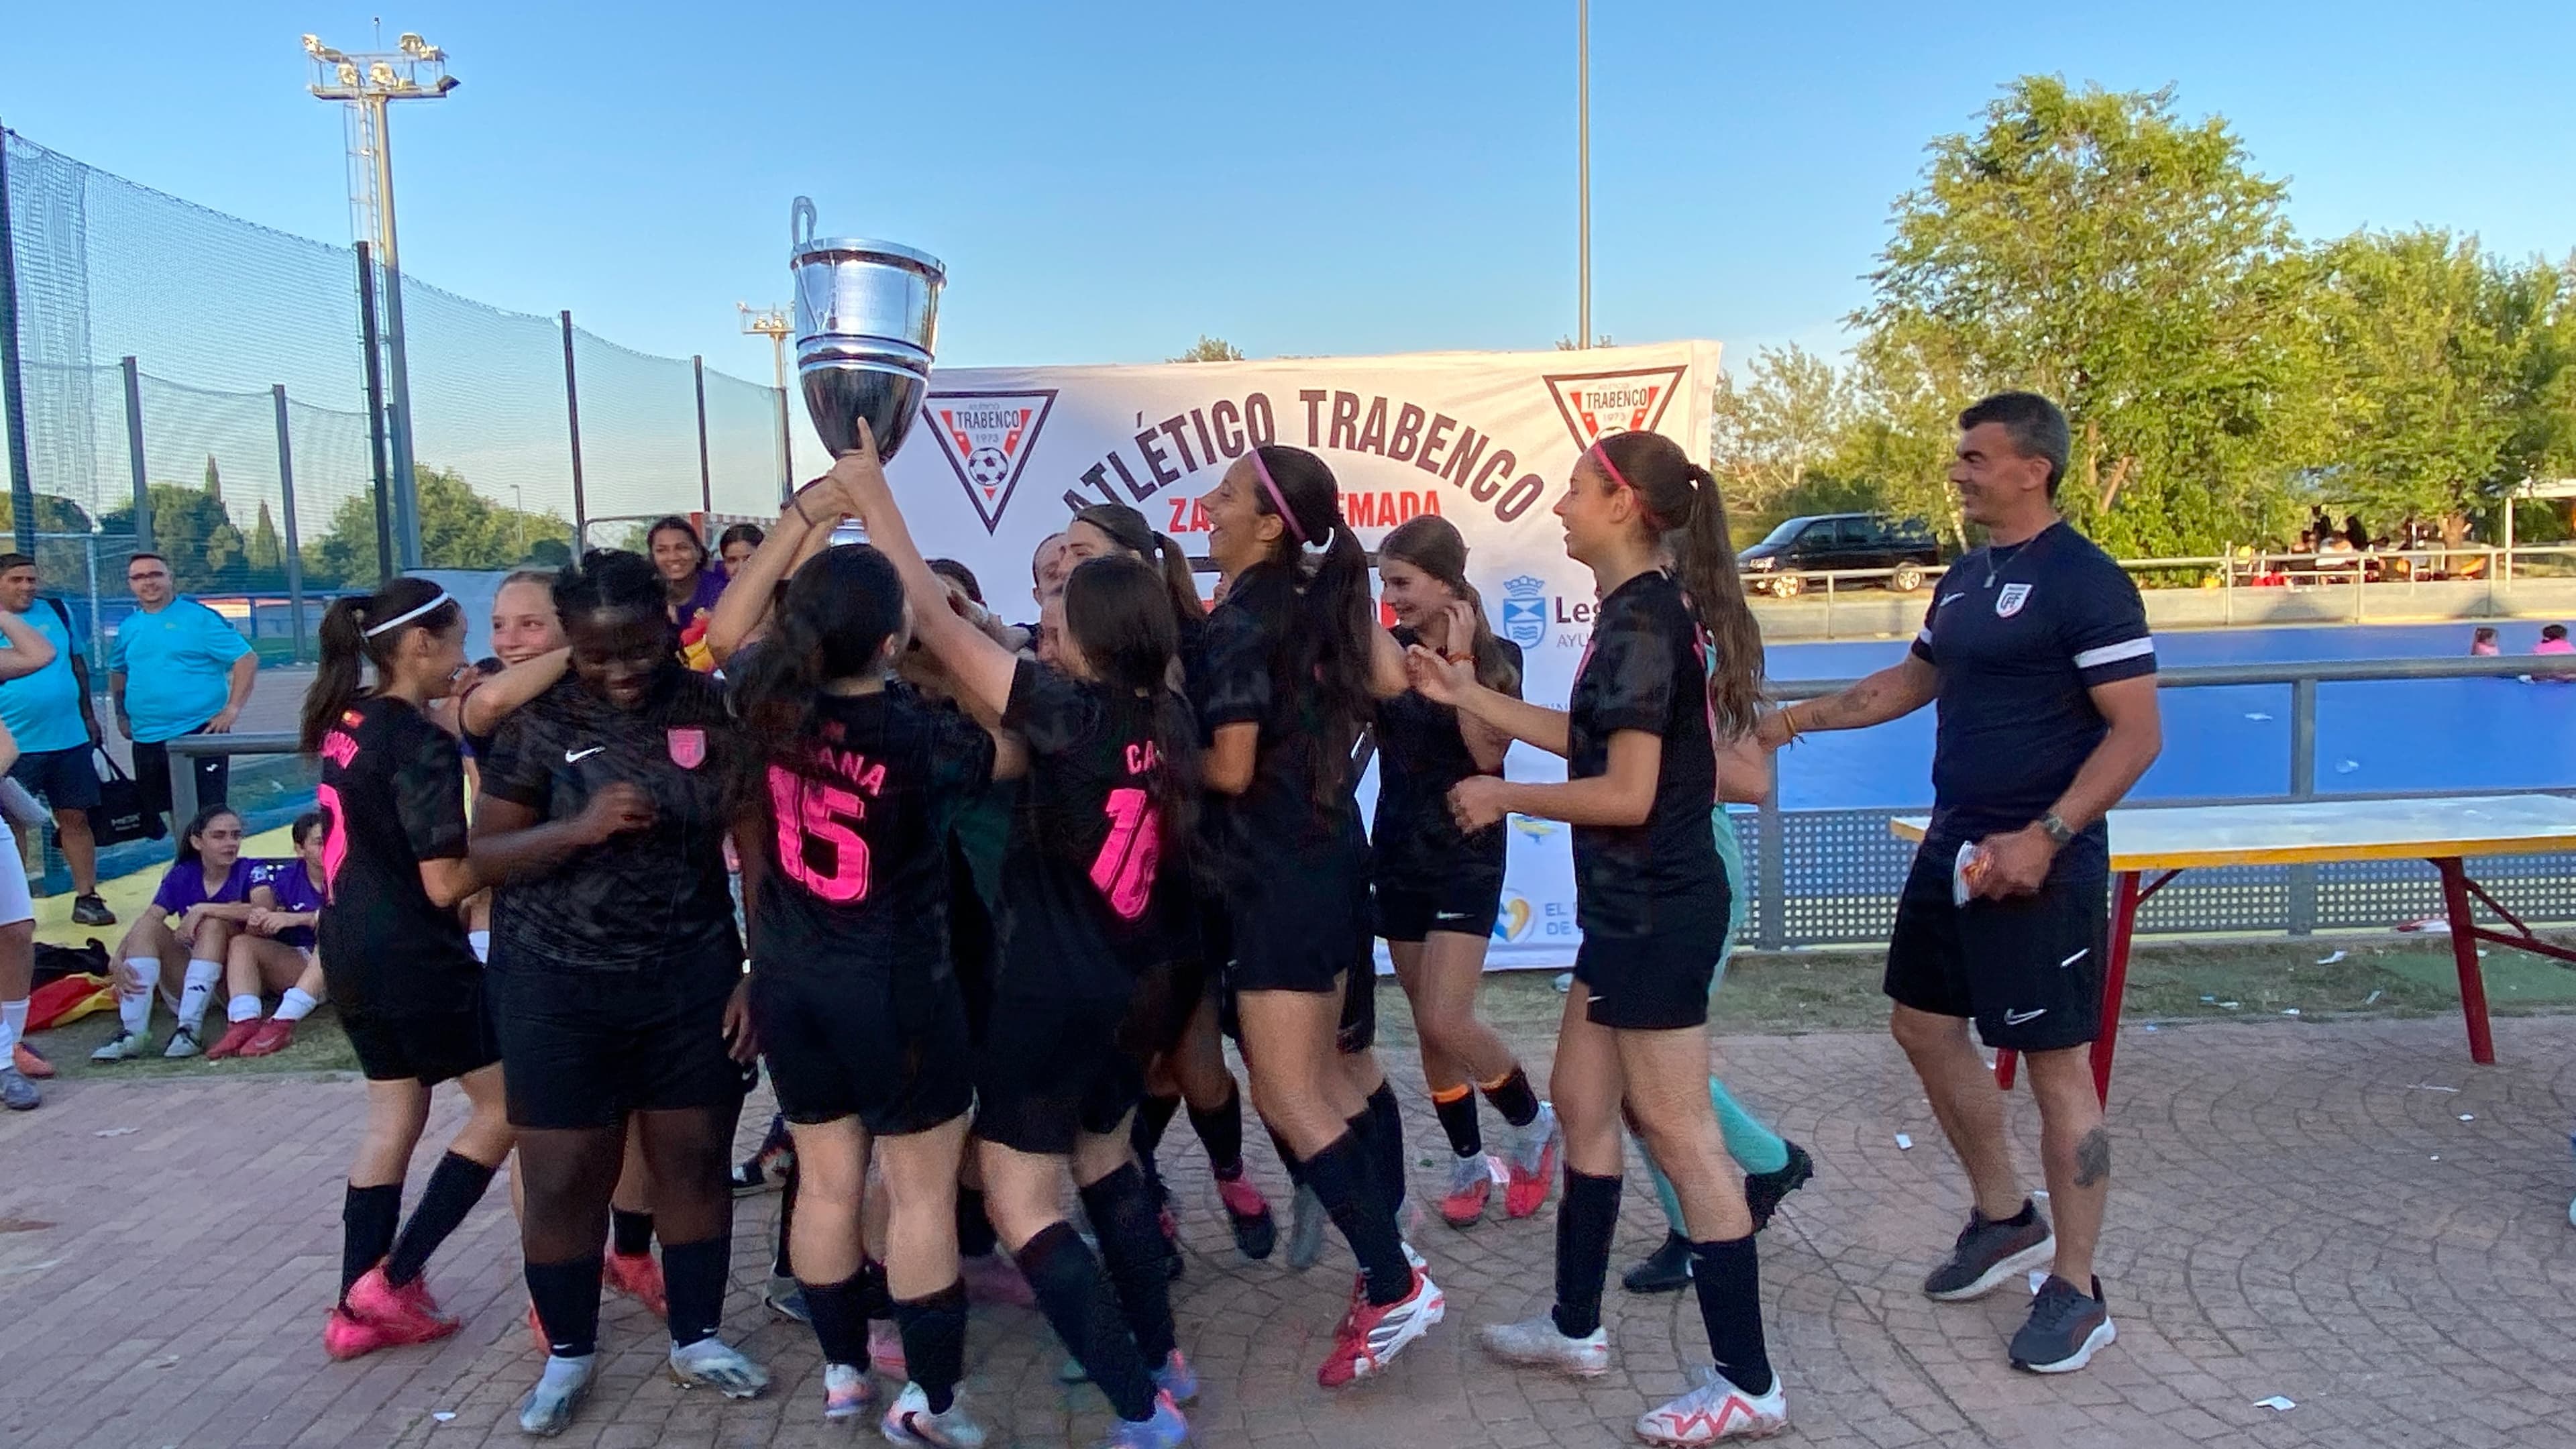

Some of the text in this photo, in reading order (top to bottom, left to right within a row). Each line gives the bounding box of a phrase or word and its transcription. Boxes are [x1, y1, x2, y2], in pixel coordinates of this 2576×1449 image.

[1586, 388, 1647, 409] TRABENCO
[956, 410, 1020, 429] TRABENCO
[1063, 389, 1544, 523] ATLÉTICO TRABENCO
[1556, 596, 1595, 624] Le
[1556, 634, 1589, 648] AYU
[1126, 741, 1157, 774] CA
[769, 764, 870, 902] 15
[1545, 902, 1568, 917] EL
[1546, 921, 1572, 935] DE
